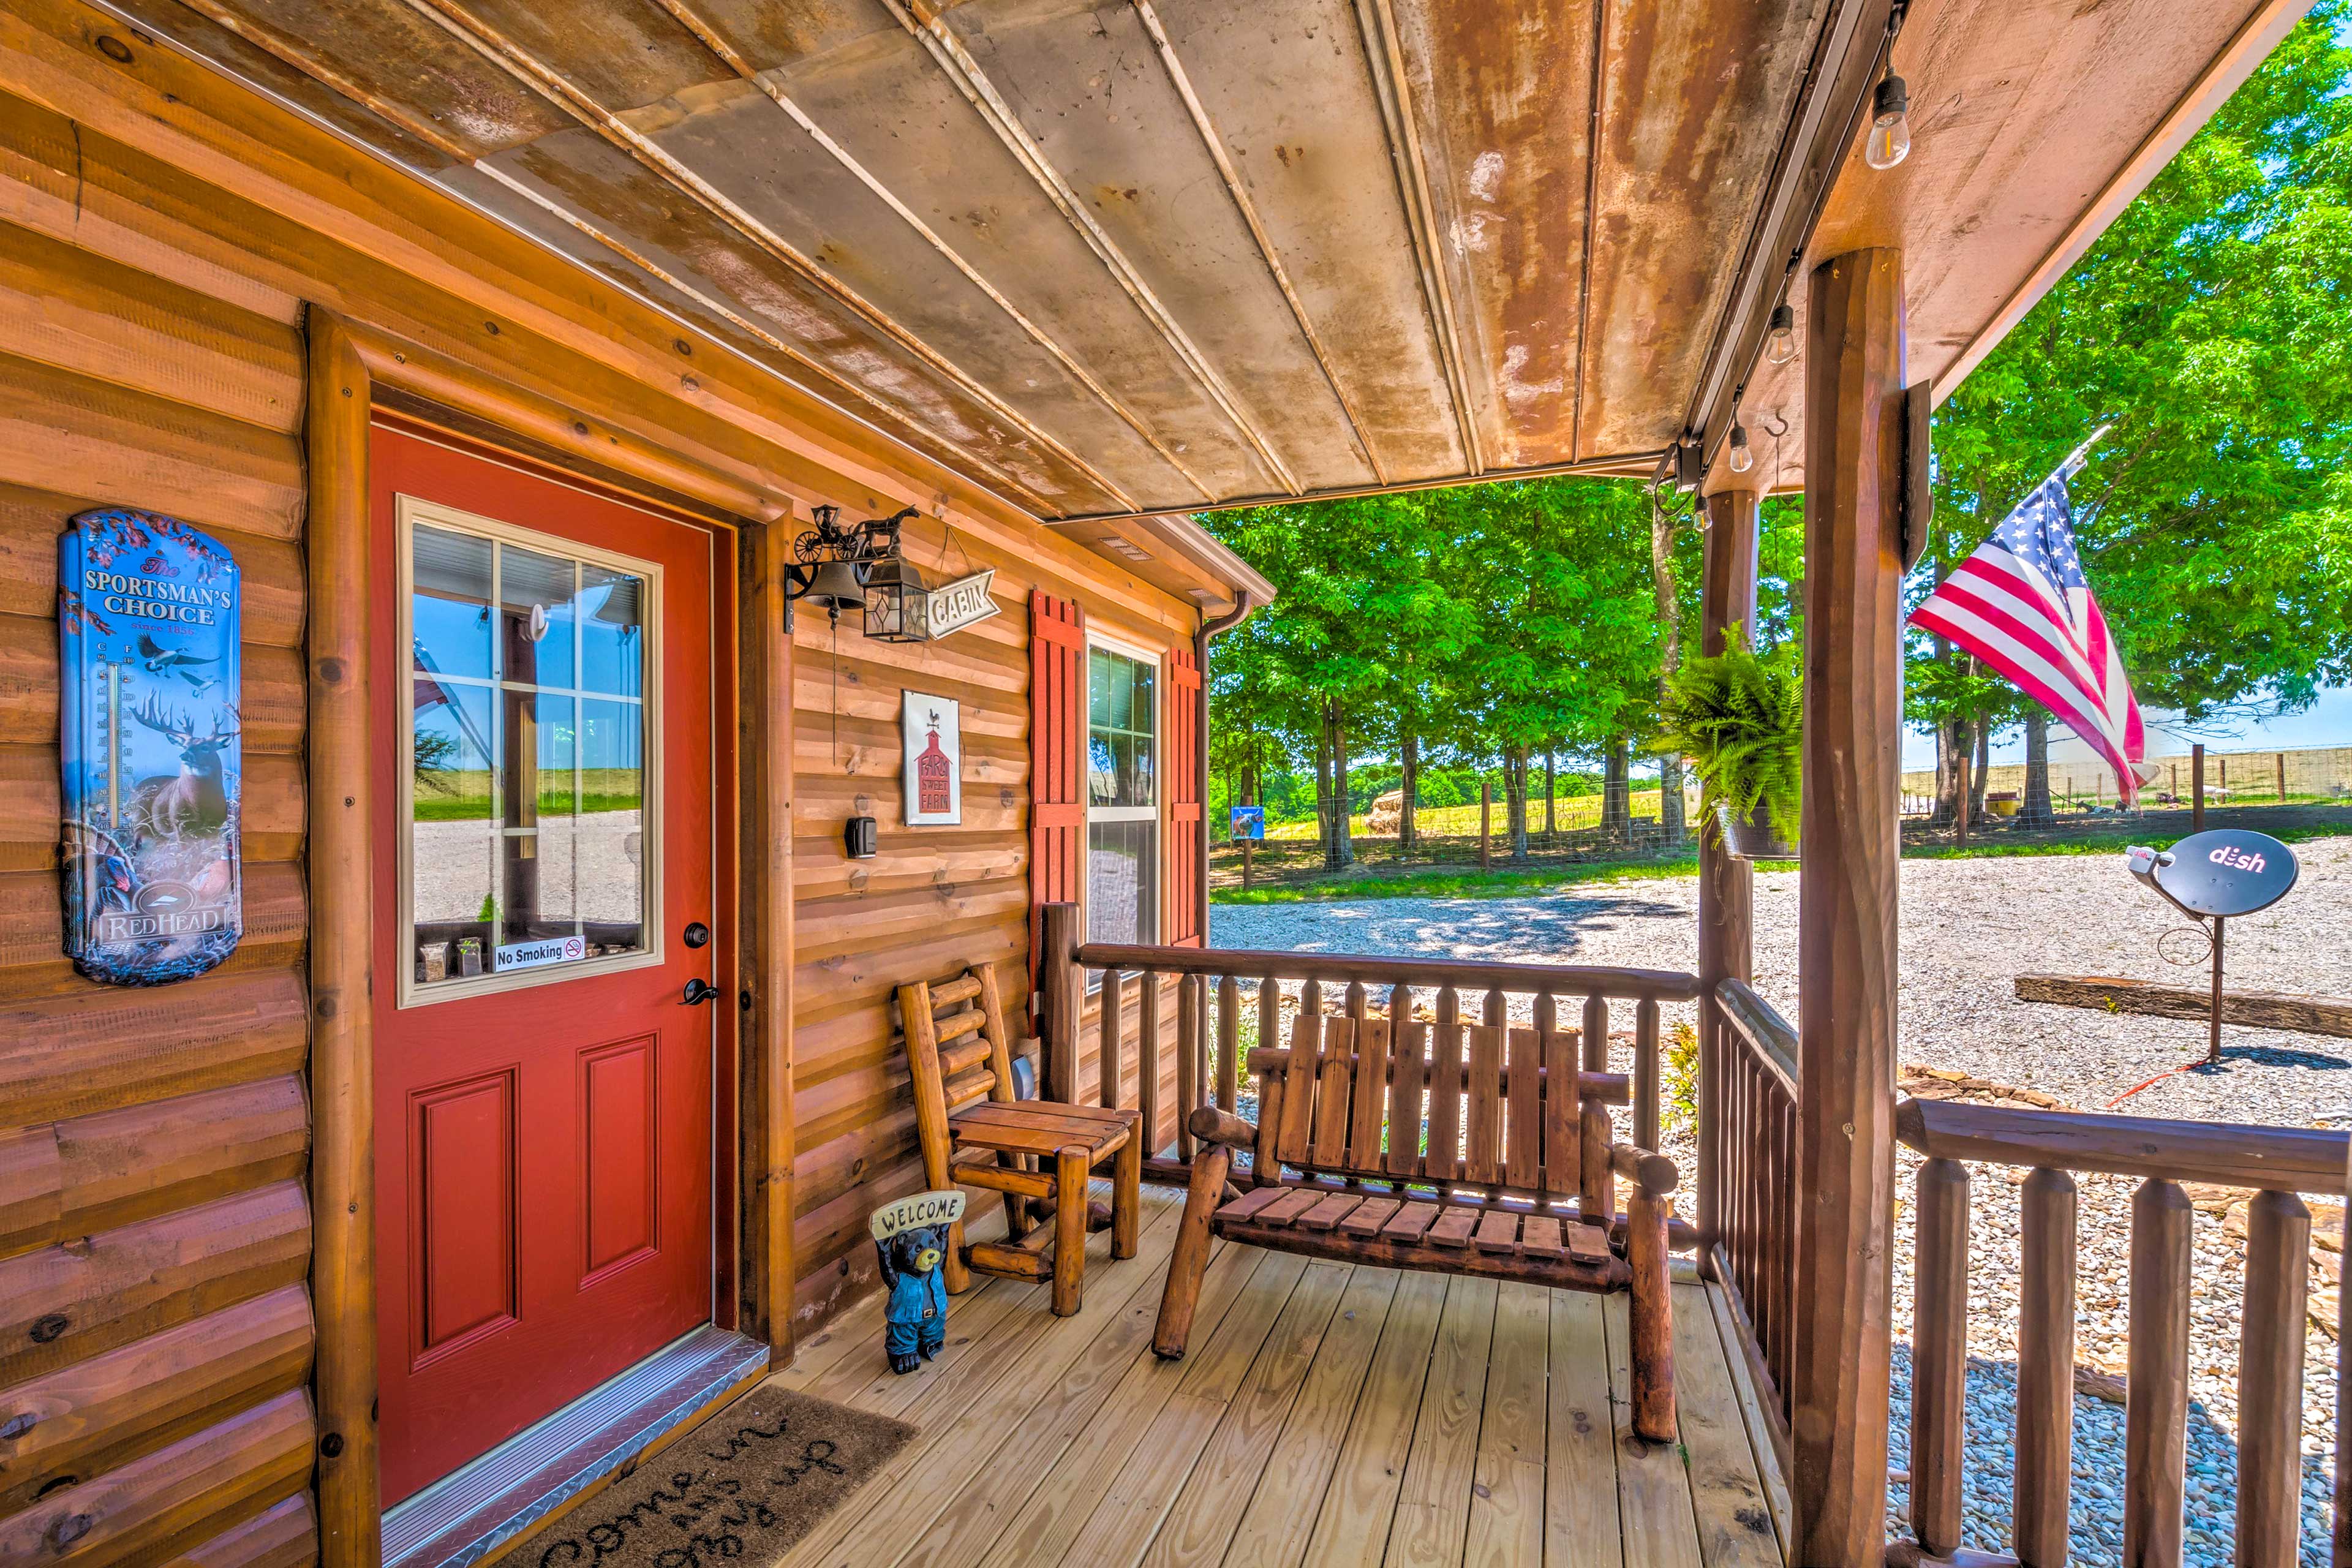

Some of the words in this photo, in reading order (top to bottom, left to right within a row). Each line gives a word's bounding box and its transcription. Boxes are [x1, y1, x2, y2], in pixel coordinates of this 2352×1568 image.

[140, 557, 179, 578] The
[85, 570, 232, 610] SPORTSMAN'S
[104, 595, 215, 626] CHOICE
[932, 584, 985, 625] CABIN
[131, 622, 163, 632] since
[167, 625, 195, 636] 1856
[125, 645, 132, 654] F
[922, 780, 948, 791] SWEET
[921, 794, 948, 809] FARM
[2209, 846, 2265, 873] dish
[110, 910, 219, 941] REDHEAD
[497, 952, 513, 966] No
[516, 945, 562, 963] Smoking
[881, 1198, 958, 1232] WELCOME
[771, 1439, 845, 1486] up
